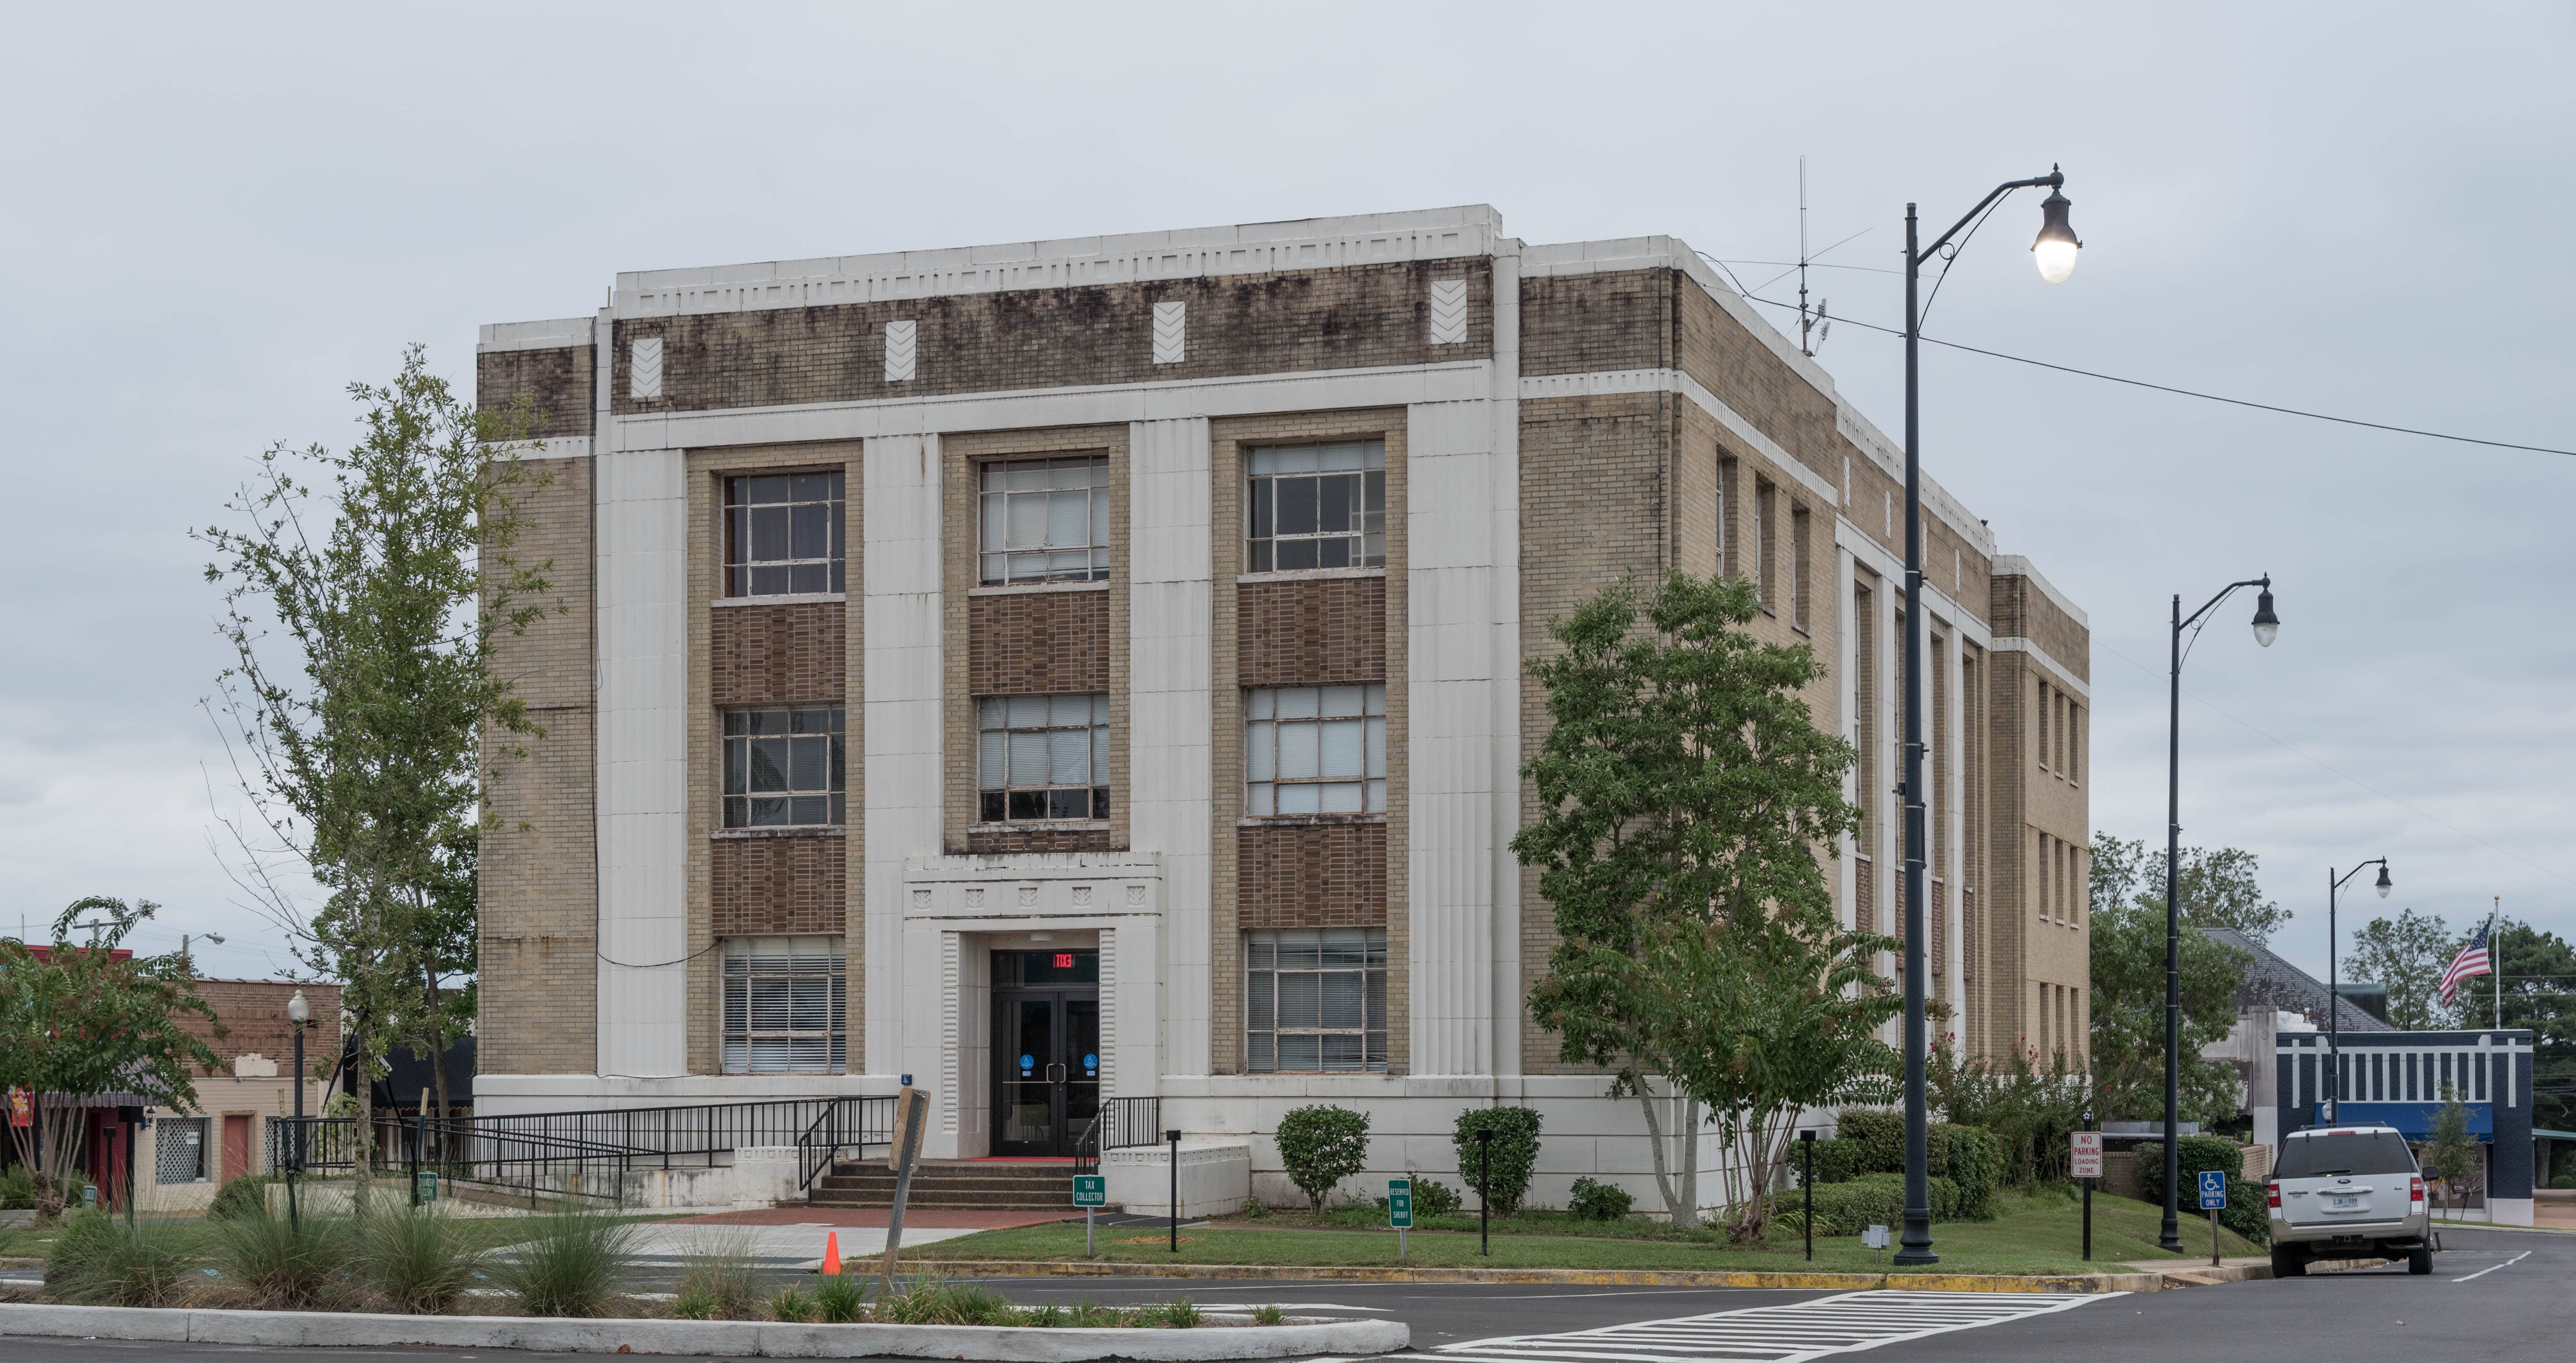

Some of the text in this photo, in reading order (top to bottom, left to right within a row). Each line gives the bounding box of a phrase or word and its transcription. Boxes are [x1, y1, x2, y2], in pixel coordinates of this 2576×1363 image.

[2081, 1136, 2092, 1144] NO
[2074, 1147, 2099, 1156] PARKING
[1085, 1180, 1094, 1189] TAX
[1076, 1192, 1103, 1201] COLLECTOR
